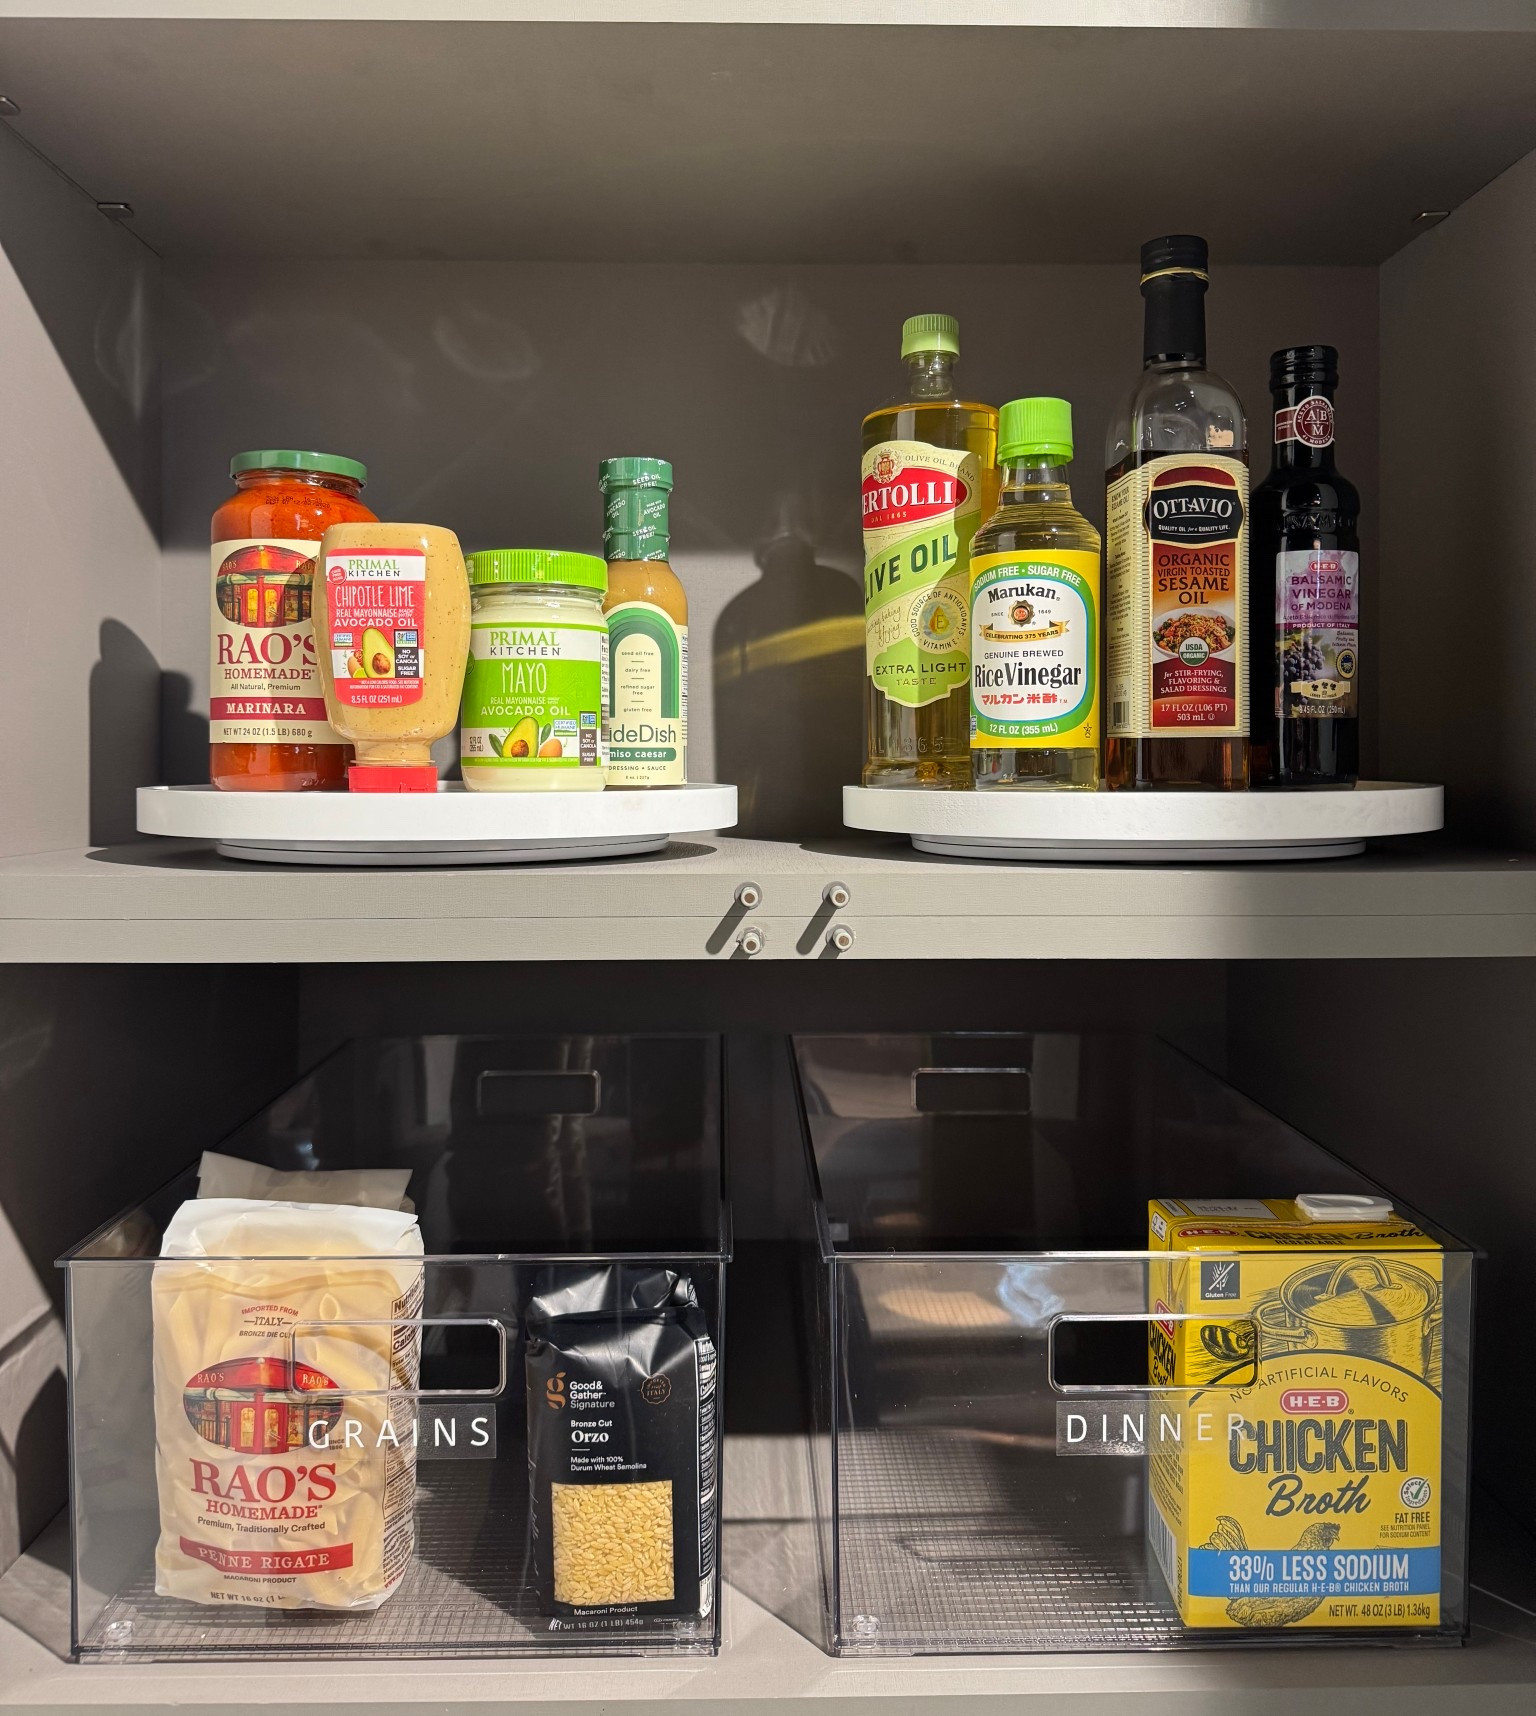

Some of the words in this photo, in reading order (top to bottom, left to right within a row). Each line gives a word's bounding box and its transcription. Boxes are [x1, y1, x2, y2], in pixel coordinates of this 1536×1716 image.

[932, 458, 948, 466] OIL
[949, 462, 975, 482] BRAND
[863, 481, 954, 514] ERTOLLI
[644, 503, 666, 516] AVOCADO
[1154, 498, 1233, 520] OTTAVIO
[911, 534, 957, 573] OIL
[348, 559, 399, 570] PRIMAL
[1158, 554, 1230, 567] ORGANIC
[974, 570, 997, 592] SODIUM
[998, 566, 1020, 578] FREE
[1027, 565, 1060, 578] SUGAR
[1061, 570, 1082, 587] FREE
[1158, 567, 1188, 578] VIRGIN
[1190, 567, 1230, 576] TOASTED
[1158, 577, 1230, 592] SESAME
[1292, 576, 1352, 586] BALSAMIC
[335, 585, 384, 607] CHIPOTLE
[389, 585, 415, 607] LIME
[933, 590, 942, 598] OF
[988, 584, 1056, 604] Marukan
[1178, 592, 1208, 604] OIL
[1292, 588, 1352, 599] VINEGAR
[912, 594, 932, 616] SOURCE
[1306, 602, 1352, 610] MODENA
[336, 608, 352, 617] REAL
[354, 608, 397, 617] MAYONNAISE
[334, 618, 393, 627] AVOCADO
[397, 618, 417, 627] OIL
[910, 619, 920, 638] GOOD
[490, 631, 559, 646] PRIMAL
[986, 632, 1023, 640] CELEBRATING
[1038, 630, 1059, 638] YEARS
[217, 632, 317, 666] RAO'S
[490, 646, 560, 656] KITCHEN
[923, 640, 952, 650] VITAMIN
[984, 650, 1020, 660] GENUINE
[1022, 650, 1064, 658] BREWED
[224, 668, 312, 680] HOMEMADE
[876, 664, 916, 676] EXTRA
[921, 662, 967, 672] LIGHT
[502, 662, 547, 694] MAYO
[974, 664, 1004, 688] Rice
[1004, 662, 1082, 689] Vinegar
[239, 683, 266, 691] Natural,
[267, 683, 301, 691] Premium
[896, 678, 937, 686] TASTE
[1160, 686, 1185, 694] SALAD
[490, 696, 504, 704] REAL
[505, 696, 546, 704] MAYONNAISE
[226, 703, 306, 715] MARINARA
[481, 706, 544, 716] AVOCADO
[550, 706, 570, 716] OIL
[609, 724, 677, 743] ideDish
[989, 724, 997, 733] 12
[998, 725, 1008, 734] FL
[1008, 726, 1020, 734] OZ
[1022, 725, 1040, 736] (355
[1042, 722, 1058, 734] mL)
[610, 750, 631, 758] miso
[242, 1304, 278, 1315] IMPORTED
[280, 1306, 299, 1316] FROM
[254, 1316, 284, 1326] ITALY
[198, 1372, 225, 1384] RAO'S
[302, 1374, 329, 1386] RAO'S
[1230, 1386, 1253, 1403] NO
[1258, 1366, 1337, 1391] ARTIFICIAL
[1344, 1370, 1410, 1403] FLAVORS
[570, 1390, 602, 1400] Gather
[570, 1400, 616, 1410] Signature
[570, 1420, 596, 1428] Bronze
[598, 1420, 612, 1428] Cut
[1067, 1413, 1244, 1443] DINNER
[308, 1417, 490, 1448] GRAINS
[571, 1430, 610, 1444] Orzo
[1229, 1419, 1409, 1474] CHICKEN
[616, 1462, 648, 1470] Semolina
[189, 1458, 337, 1504] RAO'S
[1404, 1481, 1422, 1495] Select
[1266, 1474, 1371, 1517] Broth
[206, 1498, 319, 1520] HOMEMADE
[1394, 1512, 1408, 1524] FAT
[1411, 1512, 1430, 1523] FREE
[198, 1516, 235, 1532] Premium,
[236, 1523, 290, 1534] Traditionally
[291, 1522, 326, 1532] Crafted
[199, 1546, 252, 1569] PENNE
[260, 1554, 330, 1569] RIGATE
[1229, 1555, 1274, 1582] 33%
[1282, 1555, 1328, 1581] LESS
[1334, 1554, 1409, 1581] SODIUM
[224, 1575, 261, 1584] MACARONI
[1230, 1583, 1250, 1594] THAN
[1254, 1583, 1270, 1594] OUR
[1272, 1583, 1309, 1593] REGULAR
[1344, 1582, 1380, 1592] CHICKEN
[1384, 1582, 1410, 1592] BROTH
[574, 1608, 608, 1616] Macaroni
[609, 1606, 638, 1614] Product
[1329, 1604, 1344, 1617] NET
[1346, 1604, 1358, 1617] WT.
[1361, 1604, 1371, 1616] 48
[1372, 1604, 1384, 1616] OZ
[1384, 1604, 1393, 1618] (3
[1394, 1604, 1406, 1618] LB)
[1407, 1604, 1430, 1619] 1.36kg
